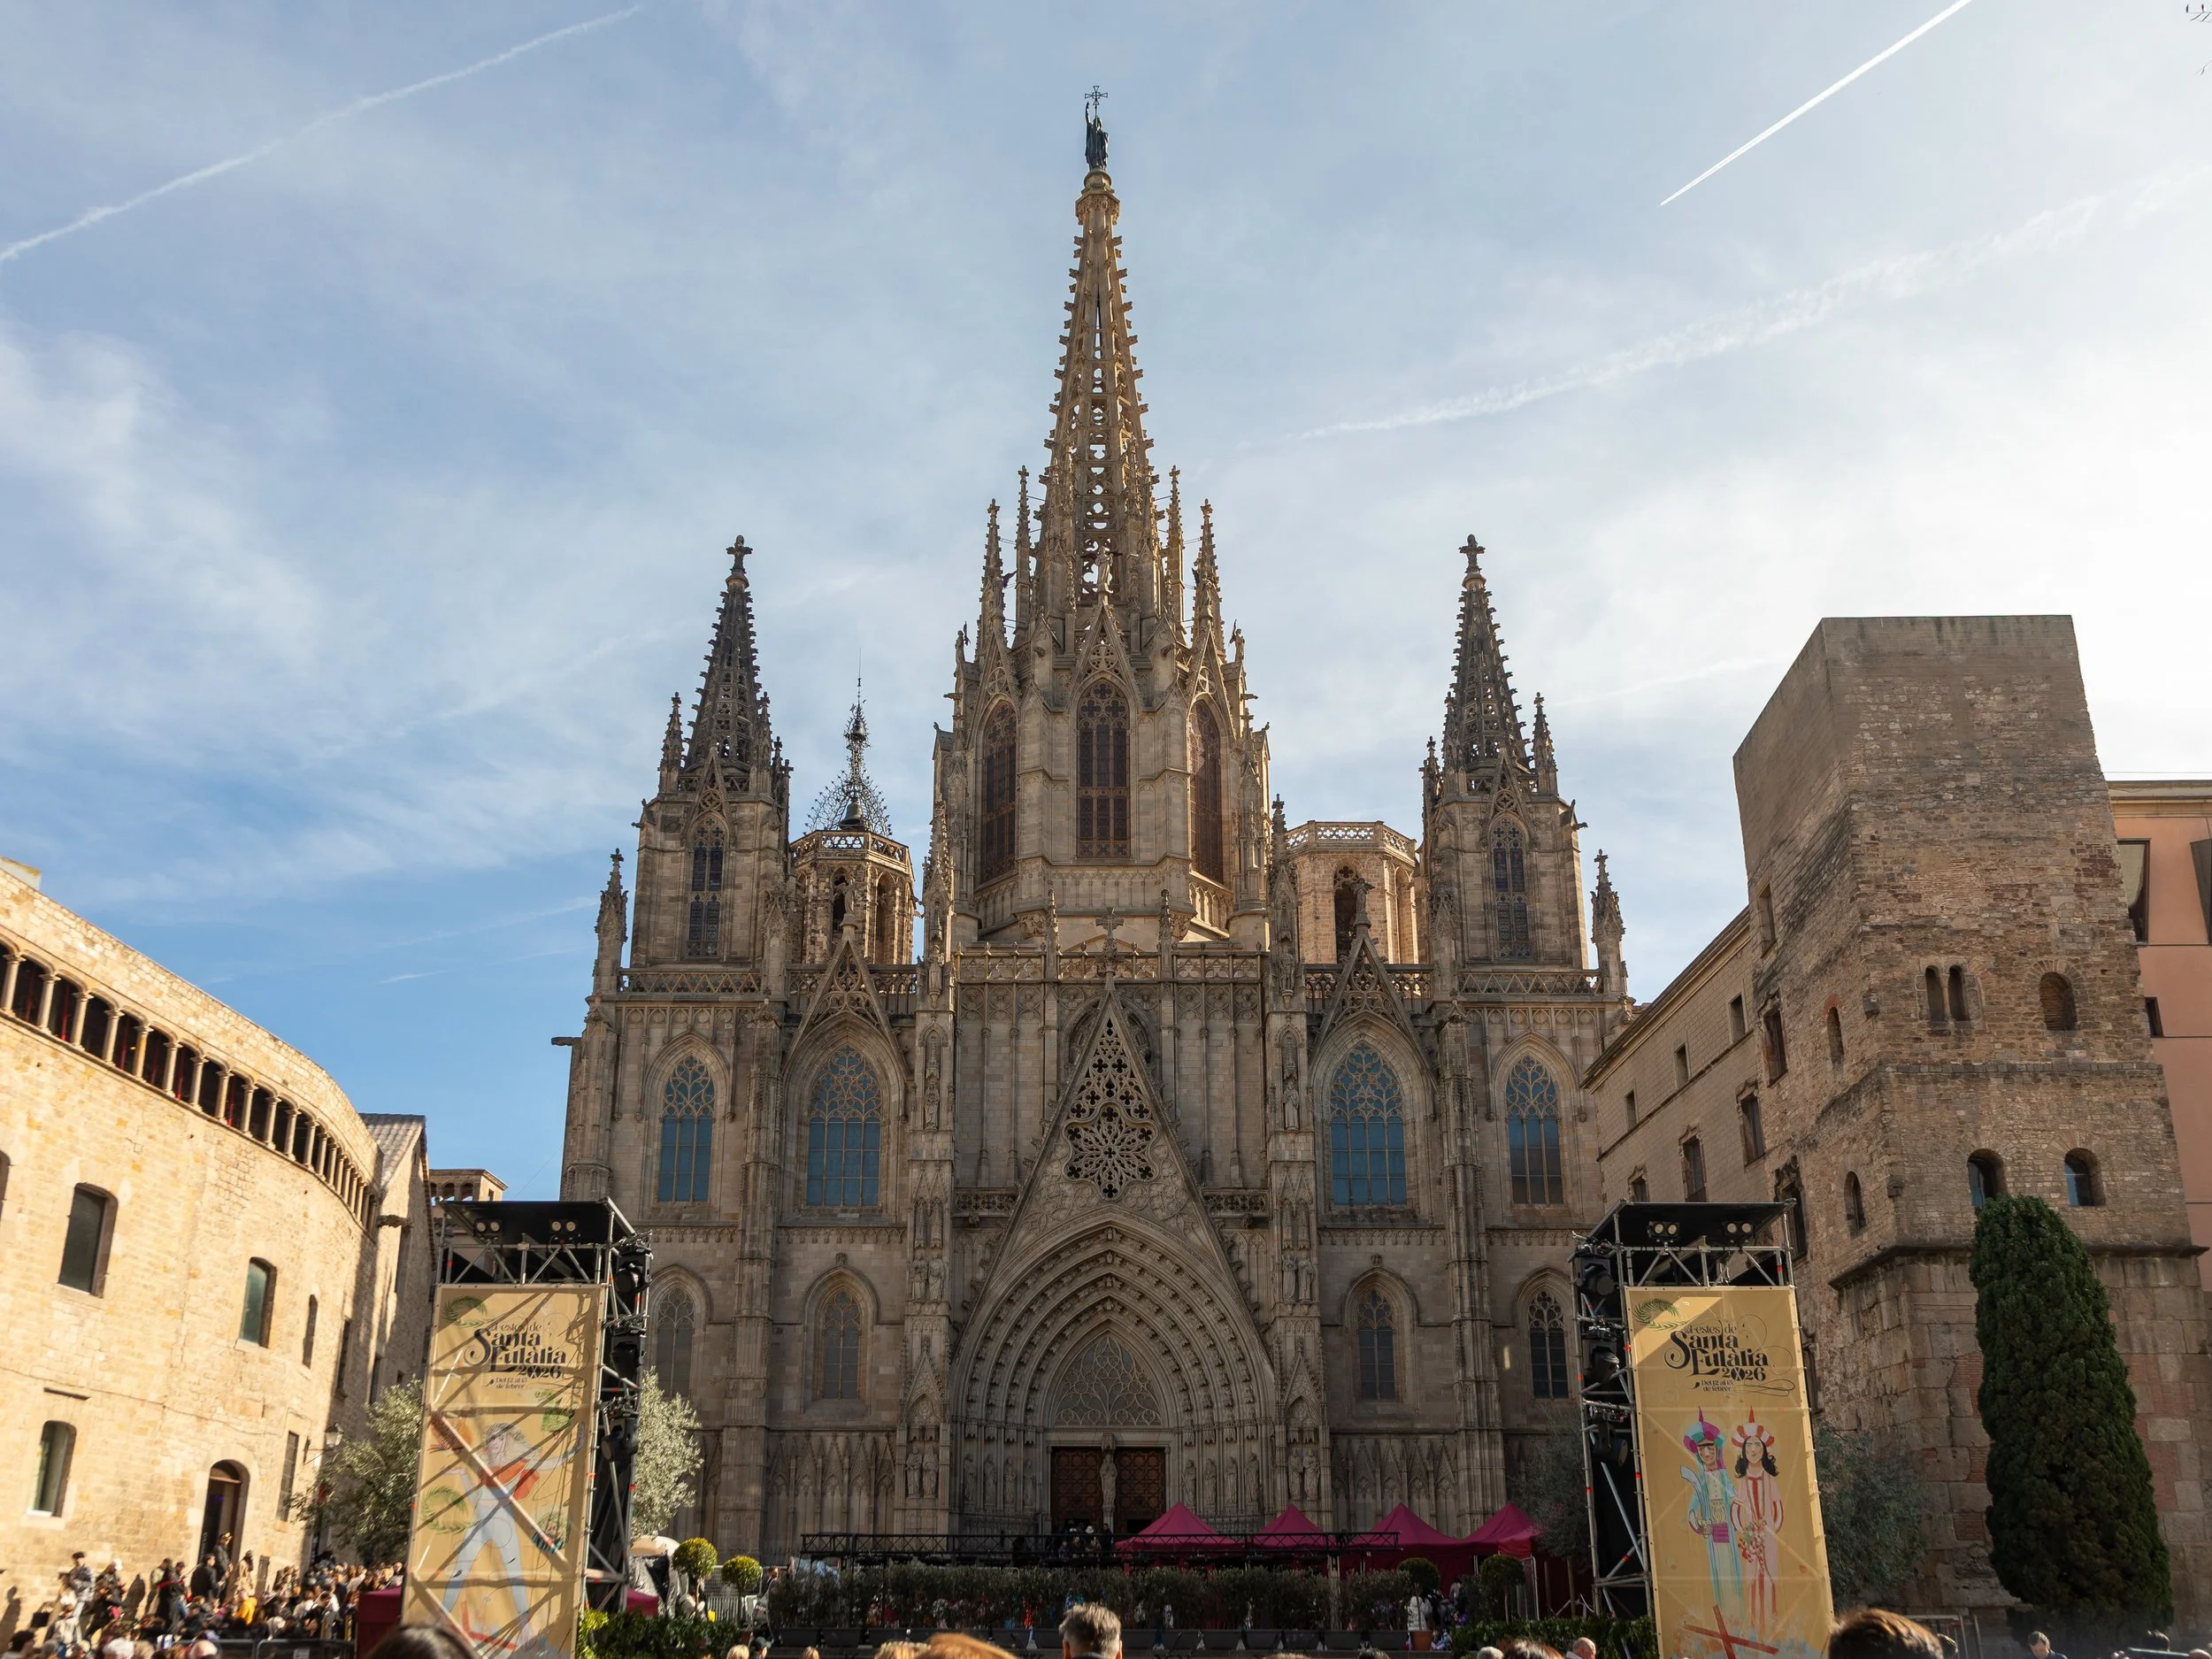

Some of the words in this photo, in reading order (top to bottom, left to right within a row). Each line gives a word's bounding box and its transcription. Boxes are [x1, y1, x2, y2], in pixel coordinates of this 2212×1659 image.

[530, 1322, 541, 1332] de
[1724, 1323, 1737, 1333] de
[465, 1328, 540, 1366] Santa
[1664, 1331, 1739, 1369] Santa
[488, 1346, 566, 1372] Eulàlia
[1686, 1348, 1769, 1376] Eulàlia
[518, 1365, 561, 1379] 2026
[1722, 1367, 1765, 1381] 2026
